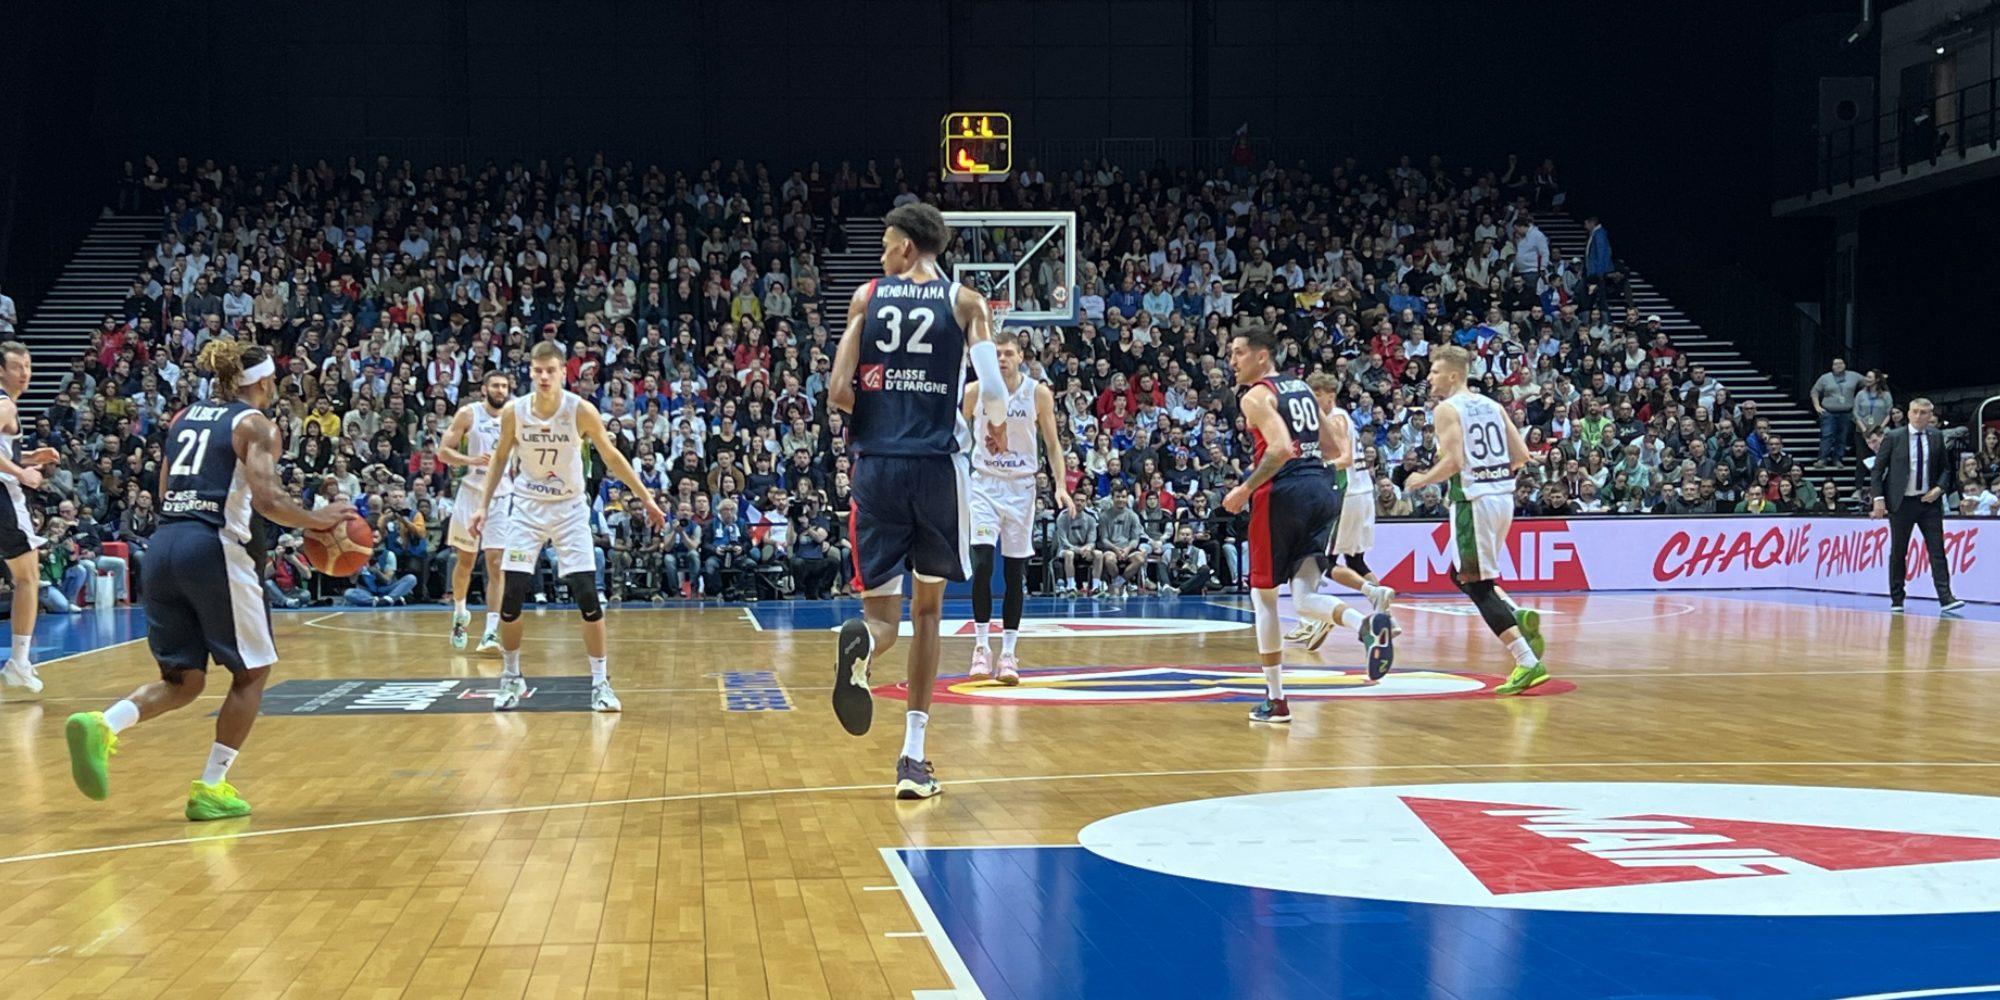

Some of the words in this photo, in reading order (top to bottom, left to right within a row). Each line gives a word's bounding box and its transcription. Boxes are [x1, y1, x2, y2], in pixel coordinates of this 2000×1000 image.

[876, 284, 945, 300] WEMBANYAMA
[875, 305, 935, 354] 32
[885, 369, 927, 381] CAISSE
[885, 379, 948, 395] D'EPARGNE
[982, 408, 1027, 418] LUVA
[1288, 396, 1320, 433] 90
[169, 428, 211, 475] 21
[522, 433, 570, 443] LIETUVA
[1469, 421, 1505, 460] 30
[534, 448, 559, 466] 77
[1653, 523, 1811, 582] CHAQUE
[1815, 526, 1888, 580] PANIER
[1905, 527, 1979, 582] OMPTE
[1480, 806, 1797, 875] MAIF
